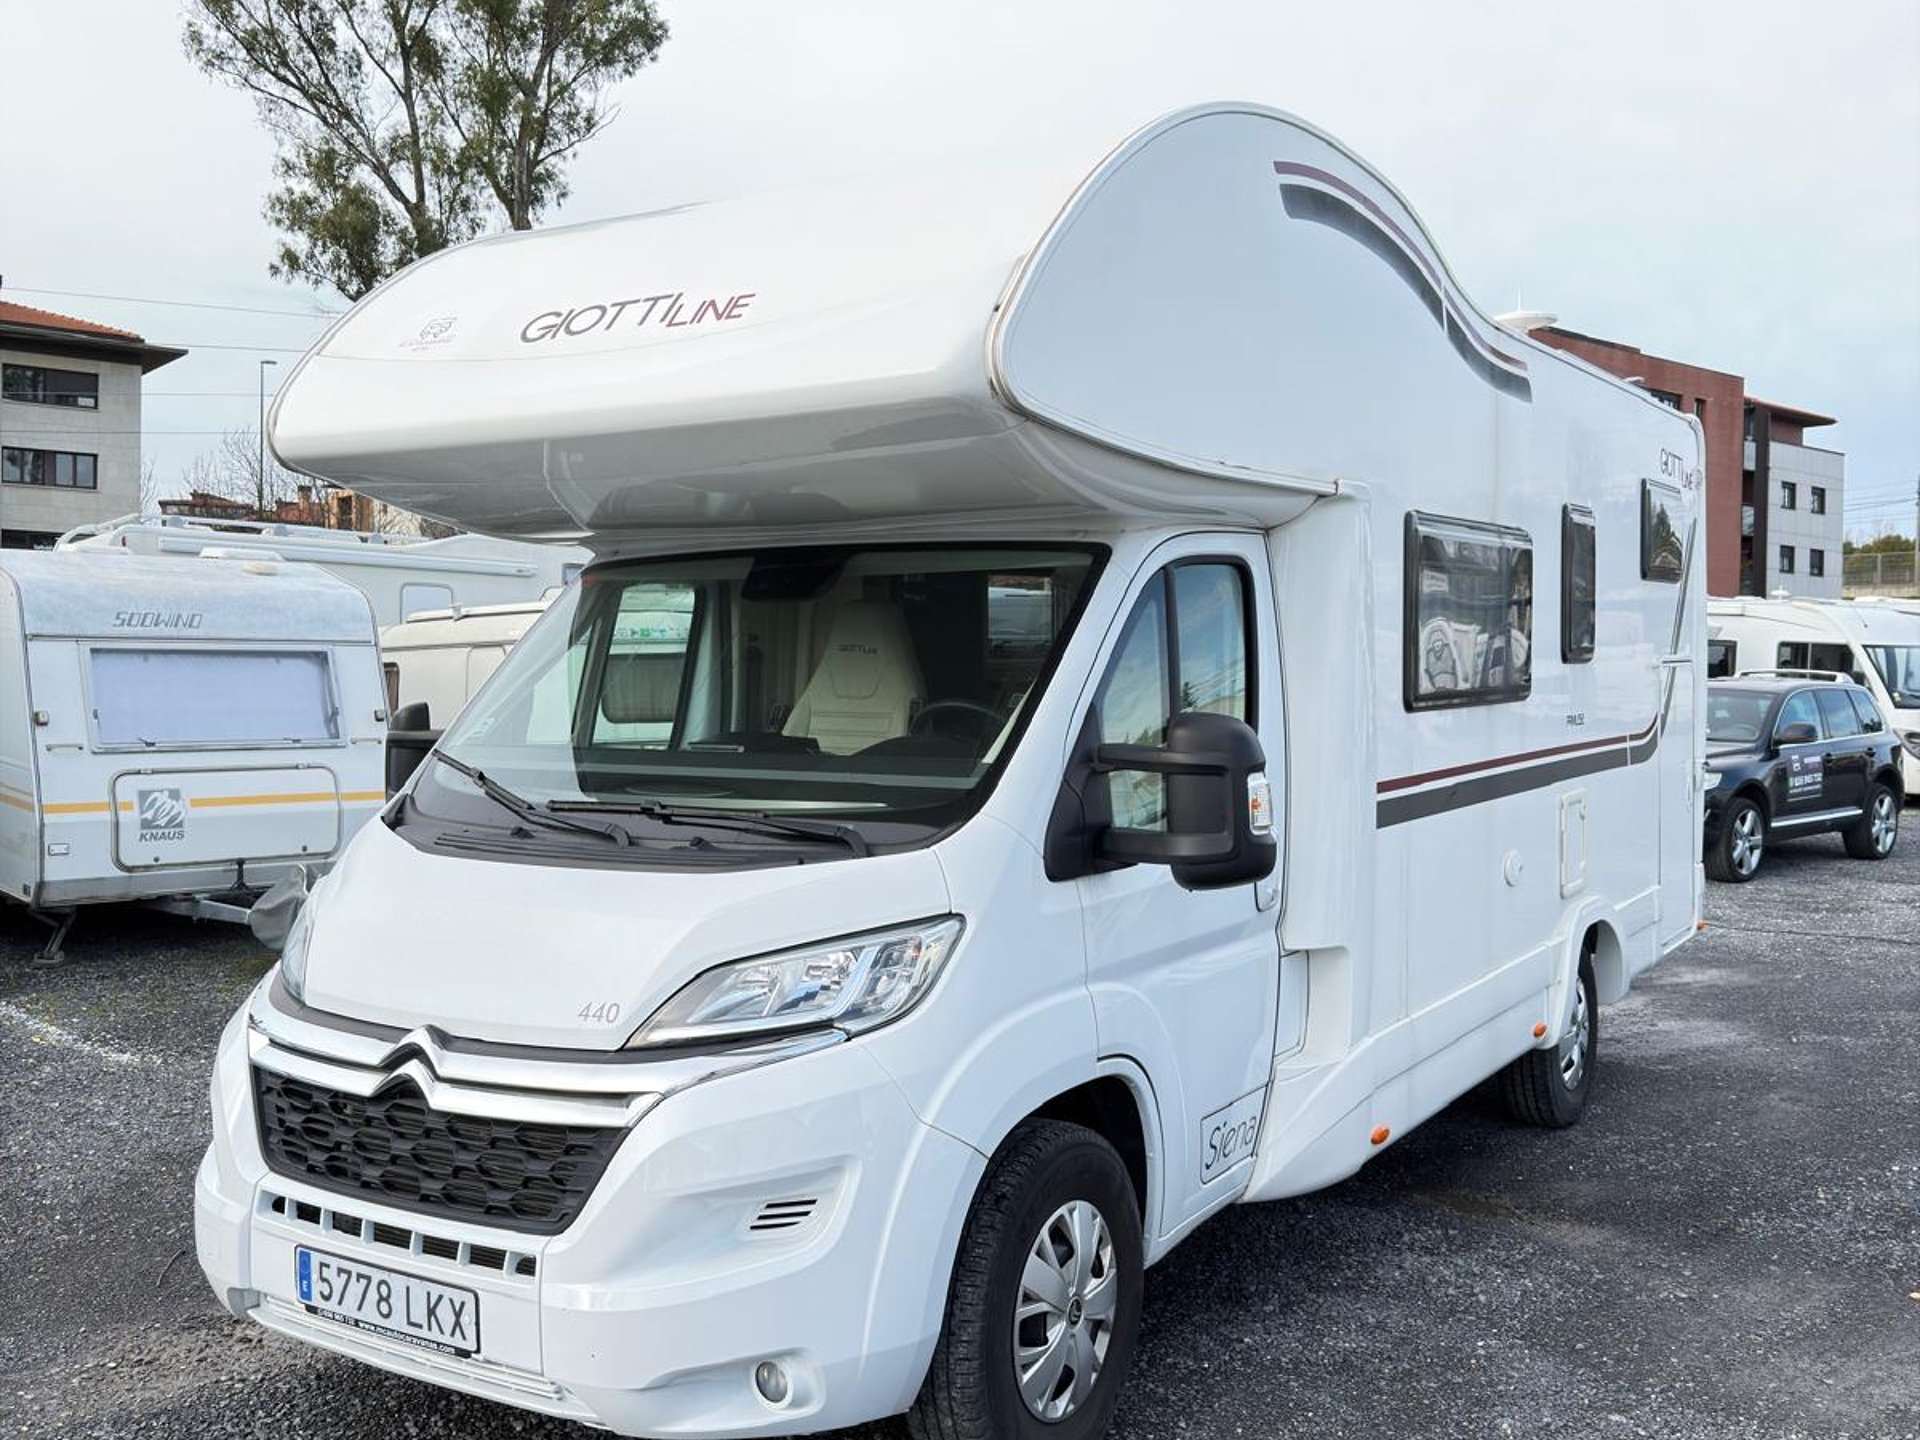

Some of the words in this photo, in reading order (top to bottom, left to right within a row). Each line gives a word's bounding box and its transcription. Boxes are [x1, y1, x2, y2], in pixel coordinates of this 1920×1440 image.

[138, 830, 185, 842] KNAUS
[578, 1002, 620, 1024] 440
[1205, 1116, 1257, 1170] Siena
[318, 1262, 393, 1319] 5778
[405, 1285, 467, 1341] LKX
